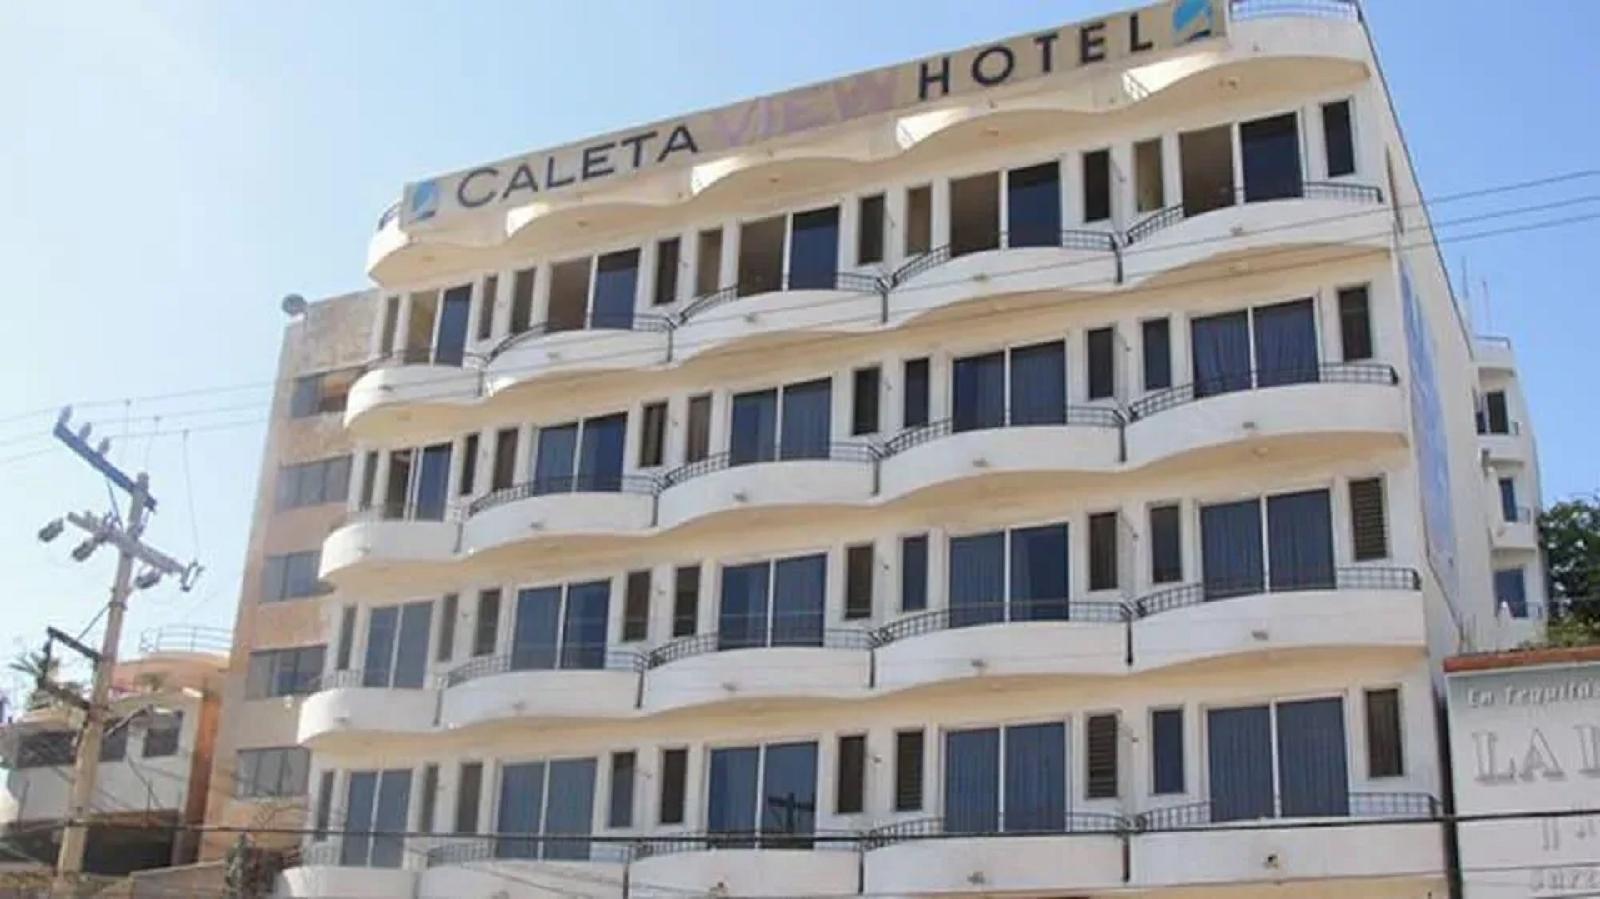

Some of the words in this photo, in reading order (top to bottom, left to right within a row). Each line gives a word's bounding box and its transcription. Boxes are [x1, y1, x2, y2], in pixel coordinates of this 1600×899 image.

[457, 124, 699, 208] CALETA
[712, 69, 899, 147] VIEW
[918, 12, 1153, 100] HOTEL
